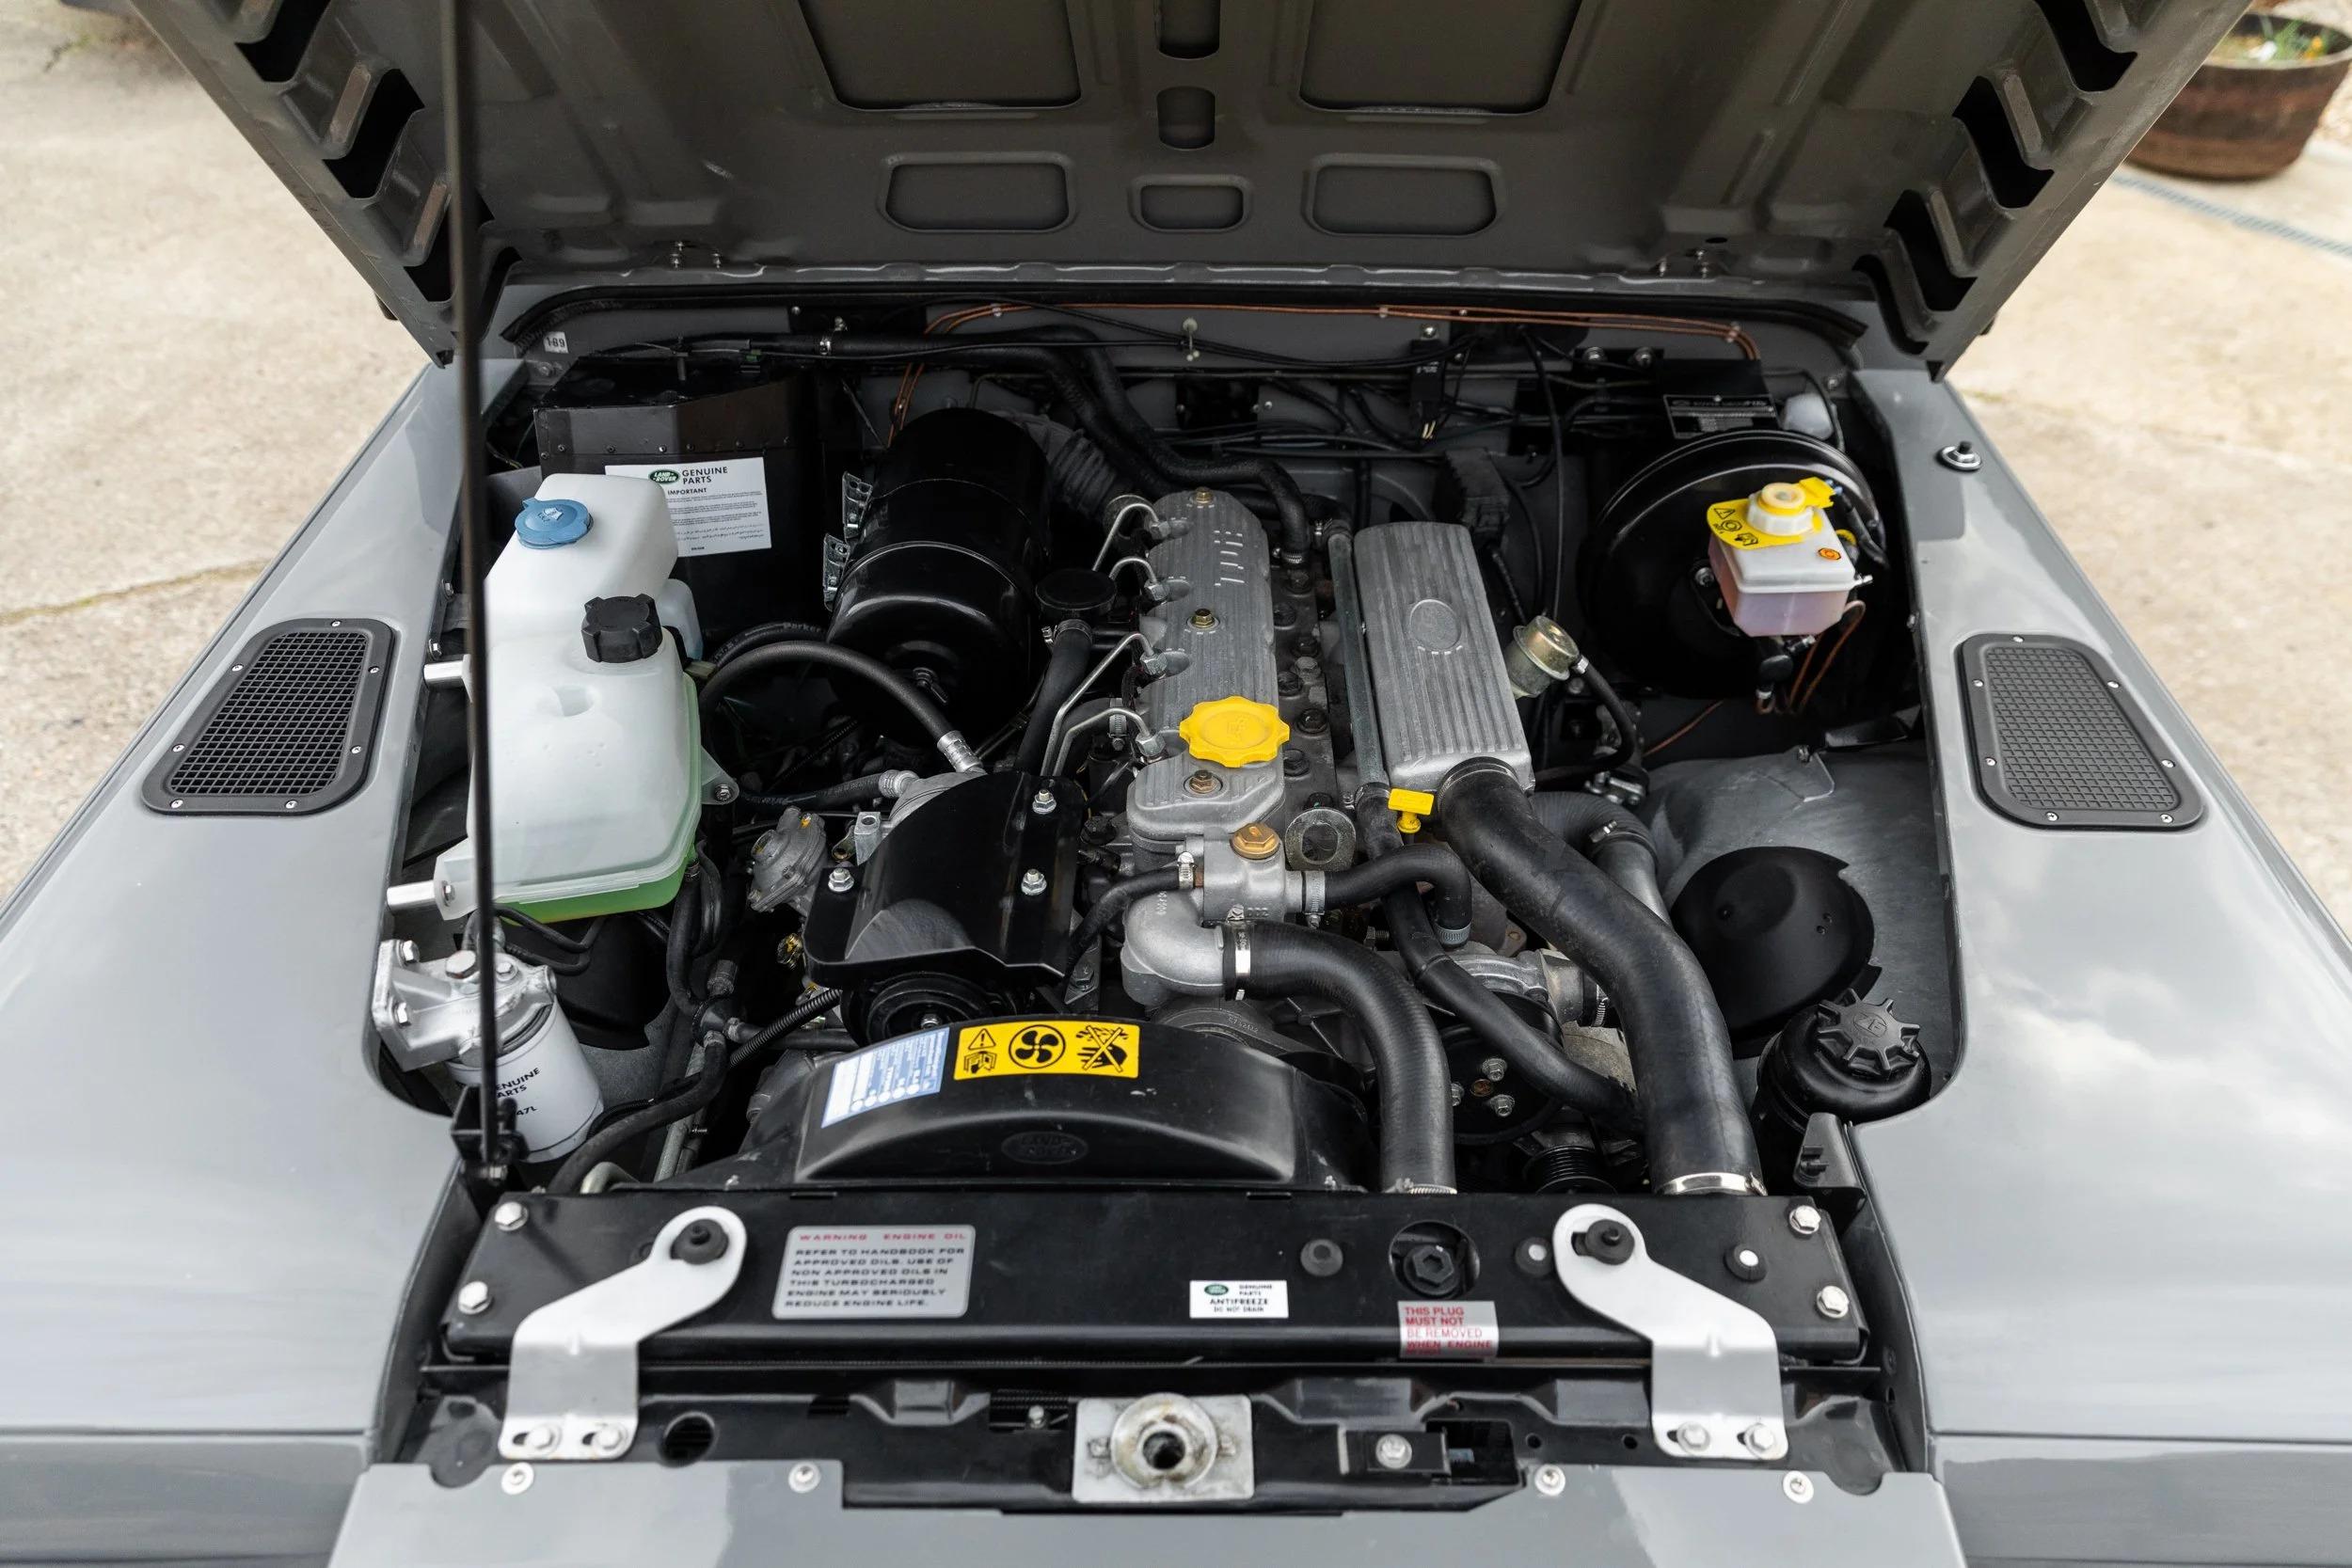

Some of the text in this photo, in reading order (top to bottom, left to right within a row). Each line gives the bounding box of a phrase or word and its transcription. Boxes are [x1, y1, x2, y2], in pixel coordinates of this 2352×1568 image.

[682, 467, 728, 477] GENUINE
[683, 476, 712, 485] PARTS
[497, 1068, 540, 1090] ENUINE
[497, 1085, 527, 1099] ARTS
[1405, 1307, 1465, 1315] THIS PLUG
[1406, 1317, 1464, 1325] MUST NOT
[1407, 1328, 1483, 1338] BE REMOVED
[1406, 1340, 1493, 1349] WHEN ENGINE
